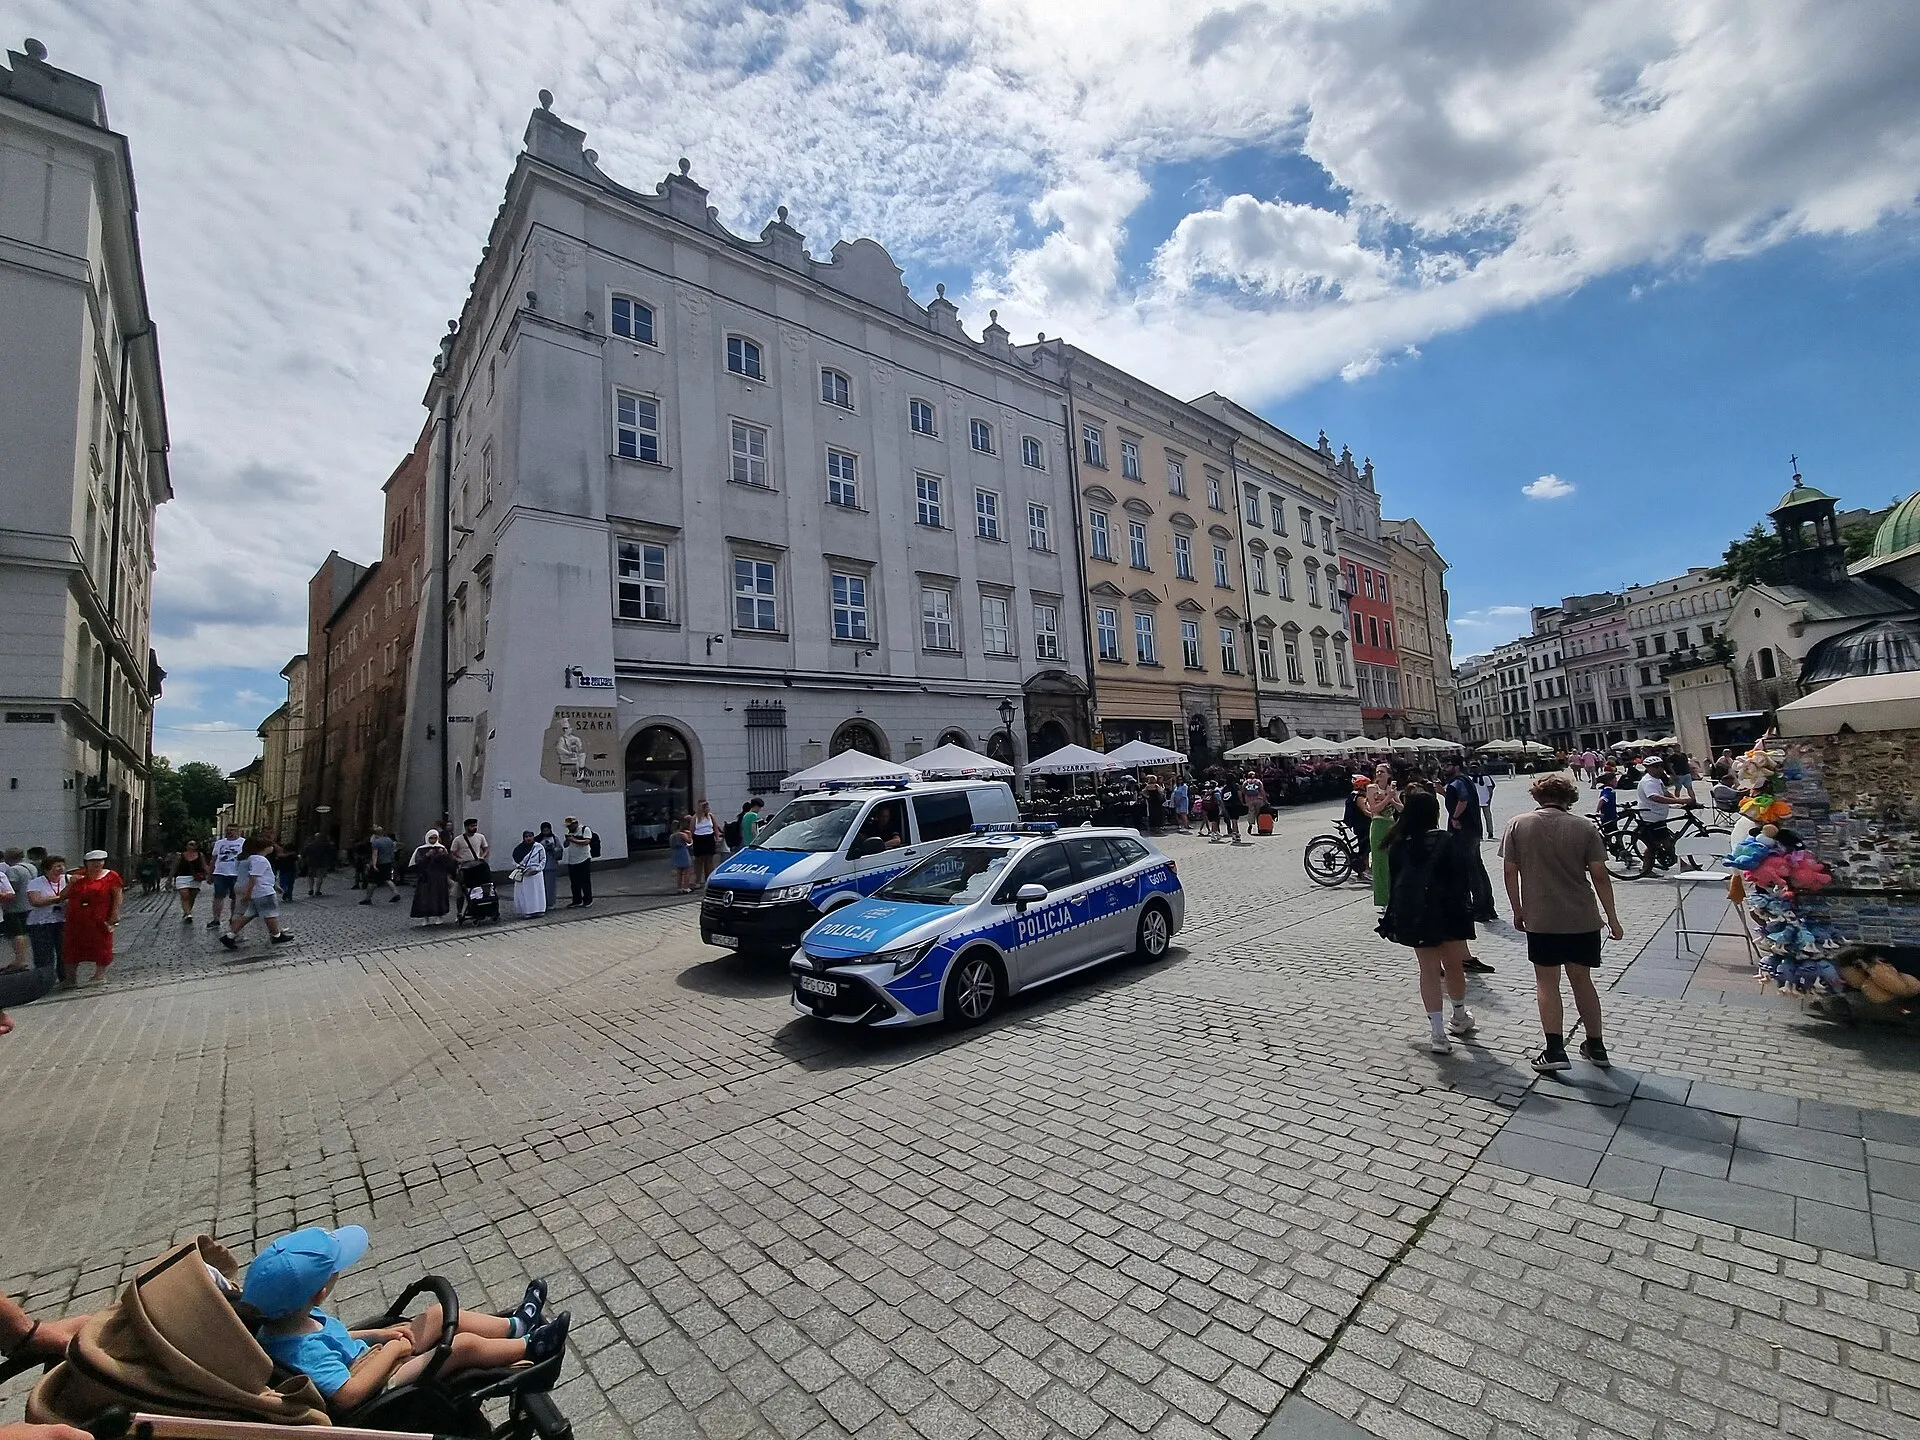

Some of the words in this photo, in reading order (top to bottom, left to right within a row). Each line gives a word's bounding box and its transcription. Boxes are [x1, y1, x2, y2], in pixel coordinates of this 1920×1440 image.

[576, 720, 613, 730] SZARA
[1062, 764, 1085, 772] SZARA
[724, 863, 770, 875] POLICJA
[1017, 905, 1073, 941] POLICJA
[816, 923, 878, 942] POLICJA
[816, 981, 836, 996] C252
